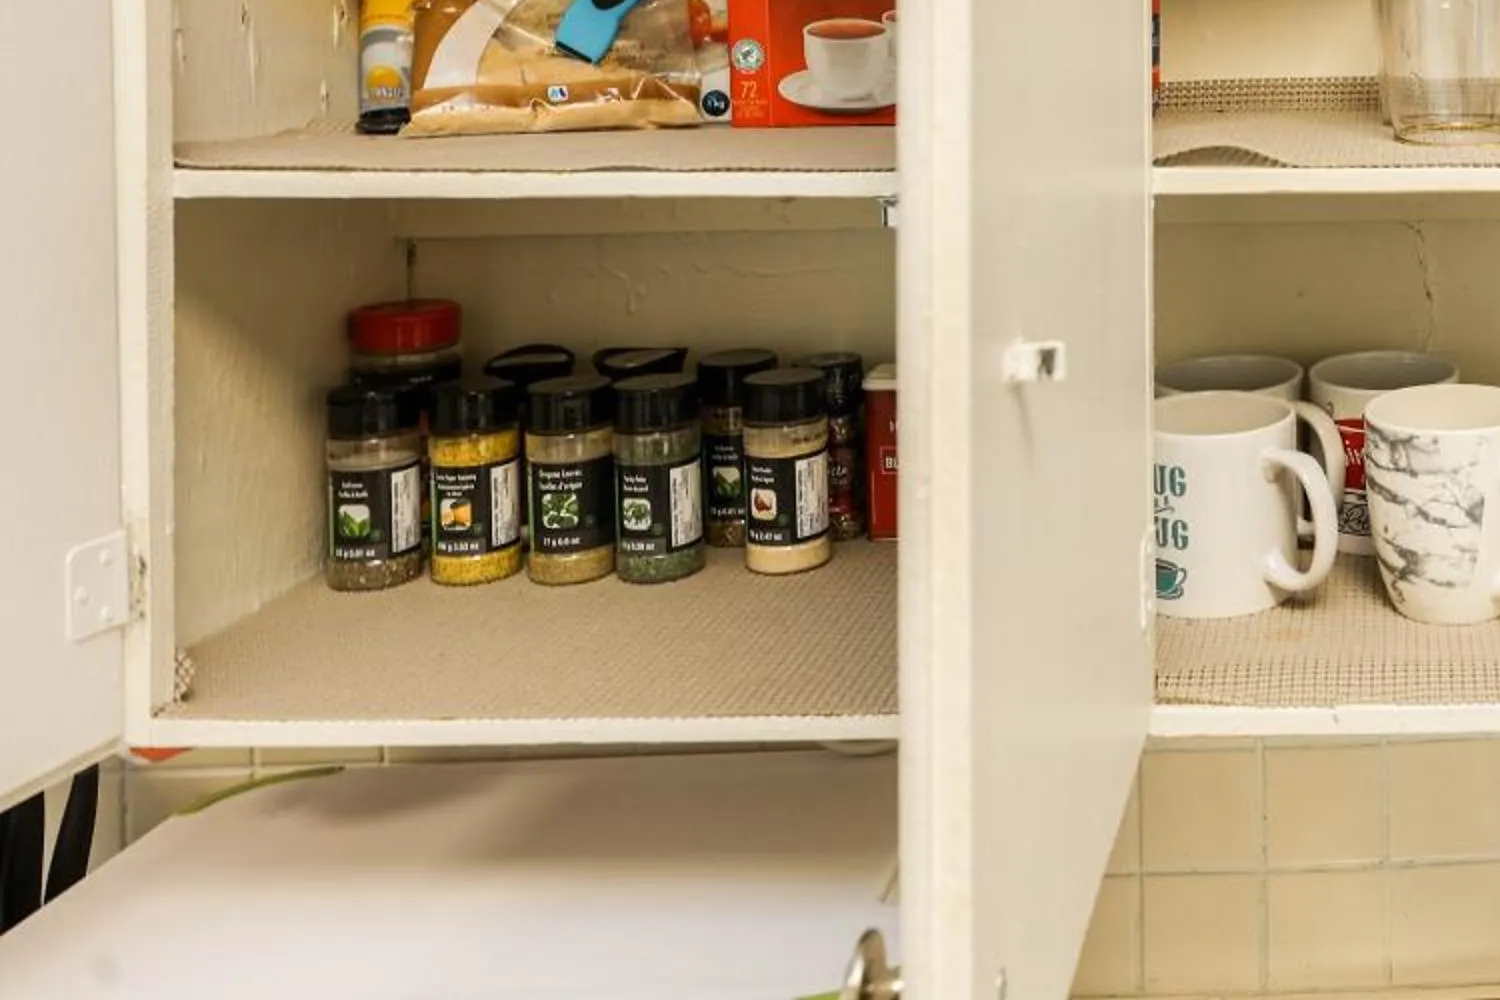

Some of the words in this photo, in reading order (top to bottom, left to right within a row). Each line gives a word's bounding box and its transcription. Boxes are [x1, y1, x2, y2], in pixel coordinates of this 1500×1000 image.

[740, 81, 757, 99] 72
[1153, 463, 1187, 497] UG
[1154, 516, 1189, 551] UG
